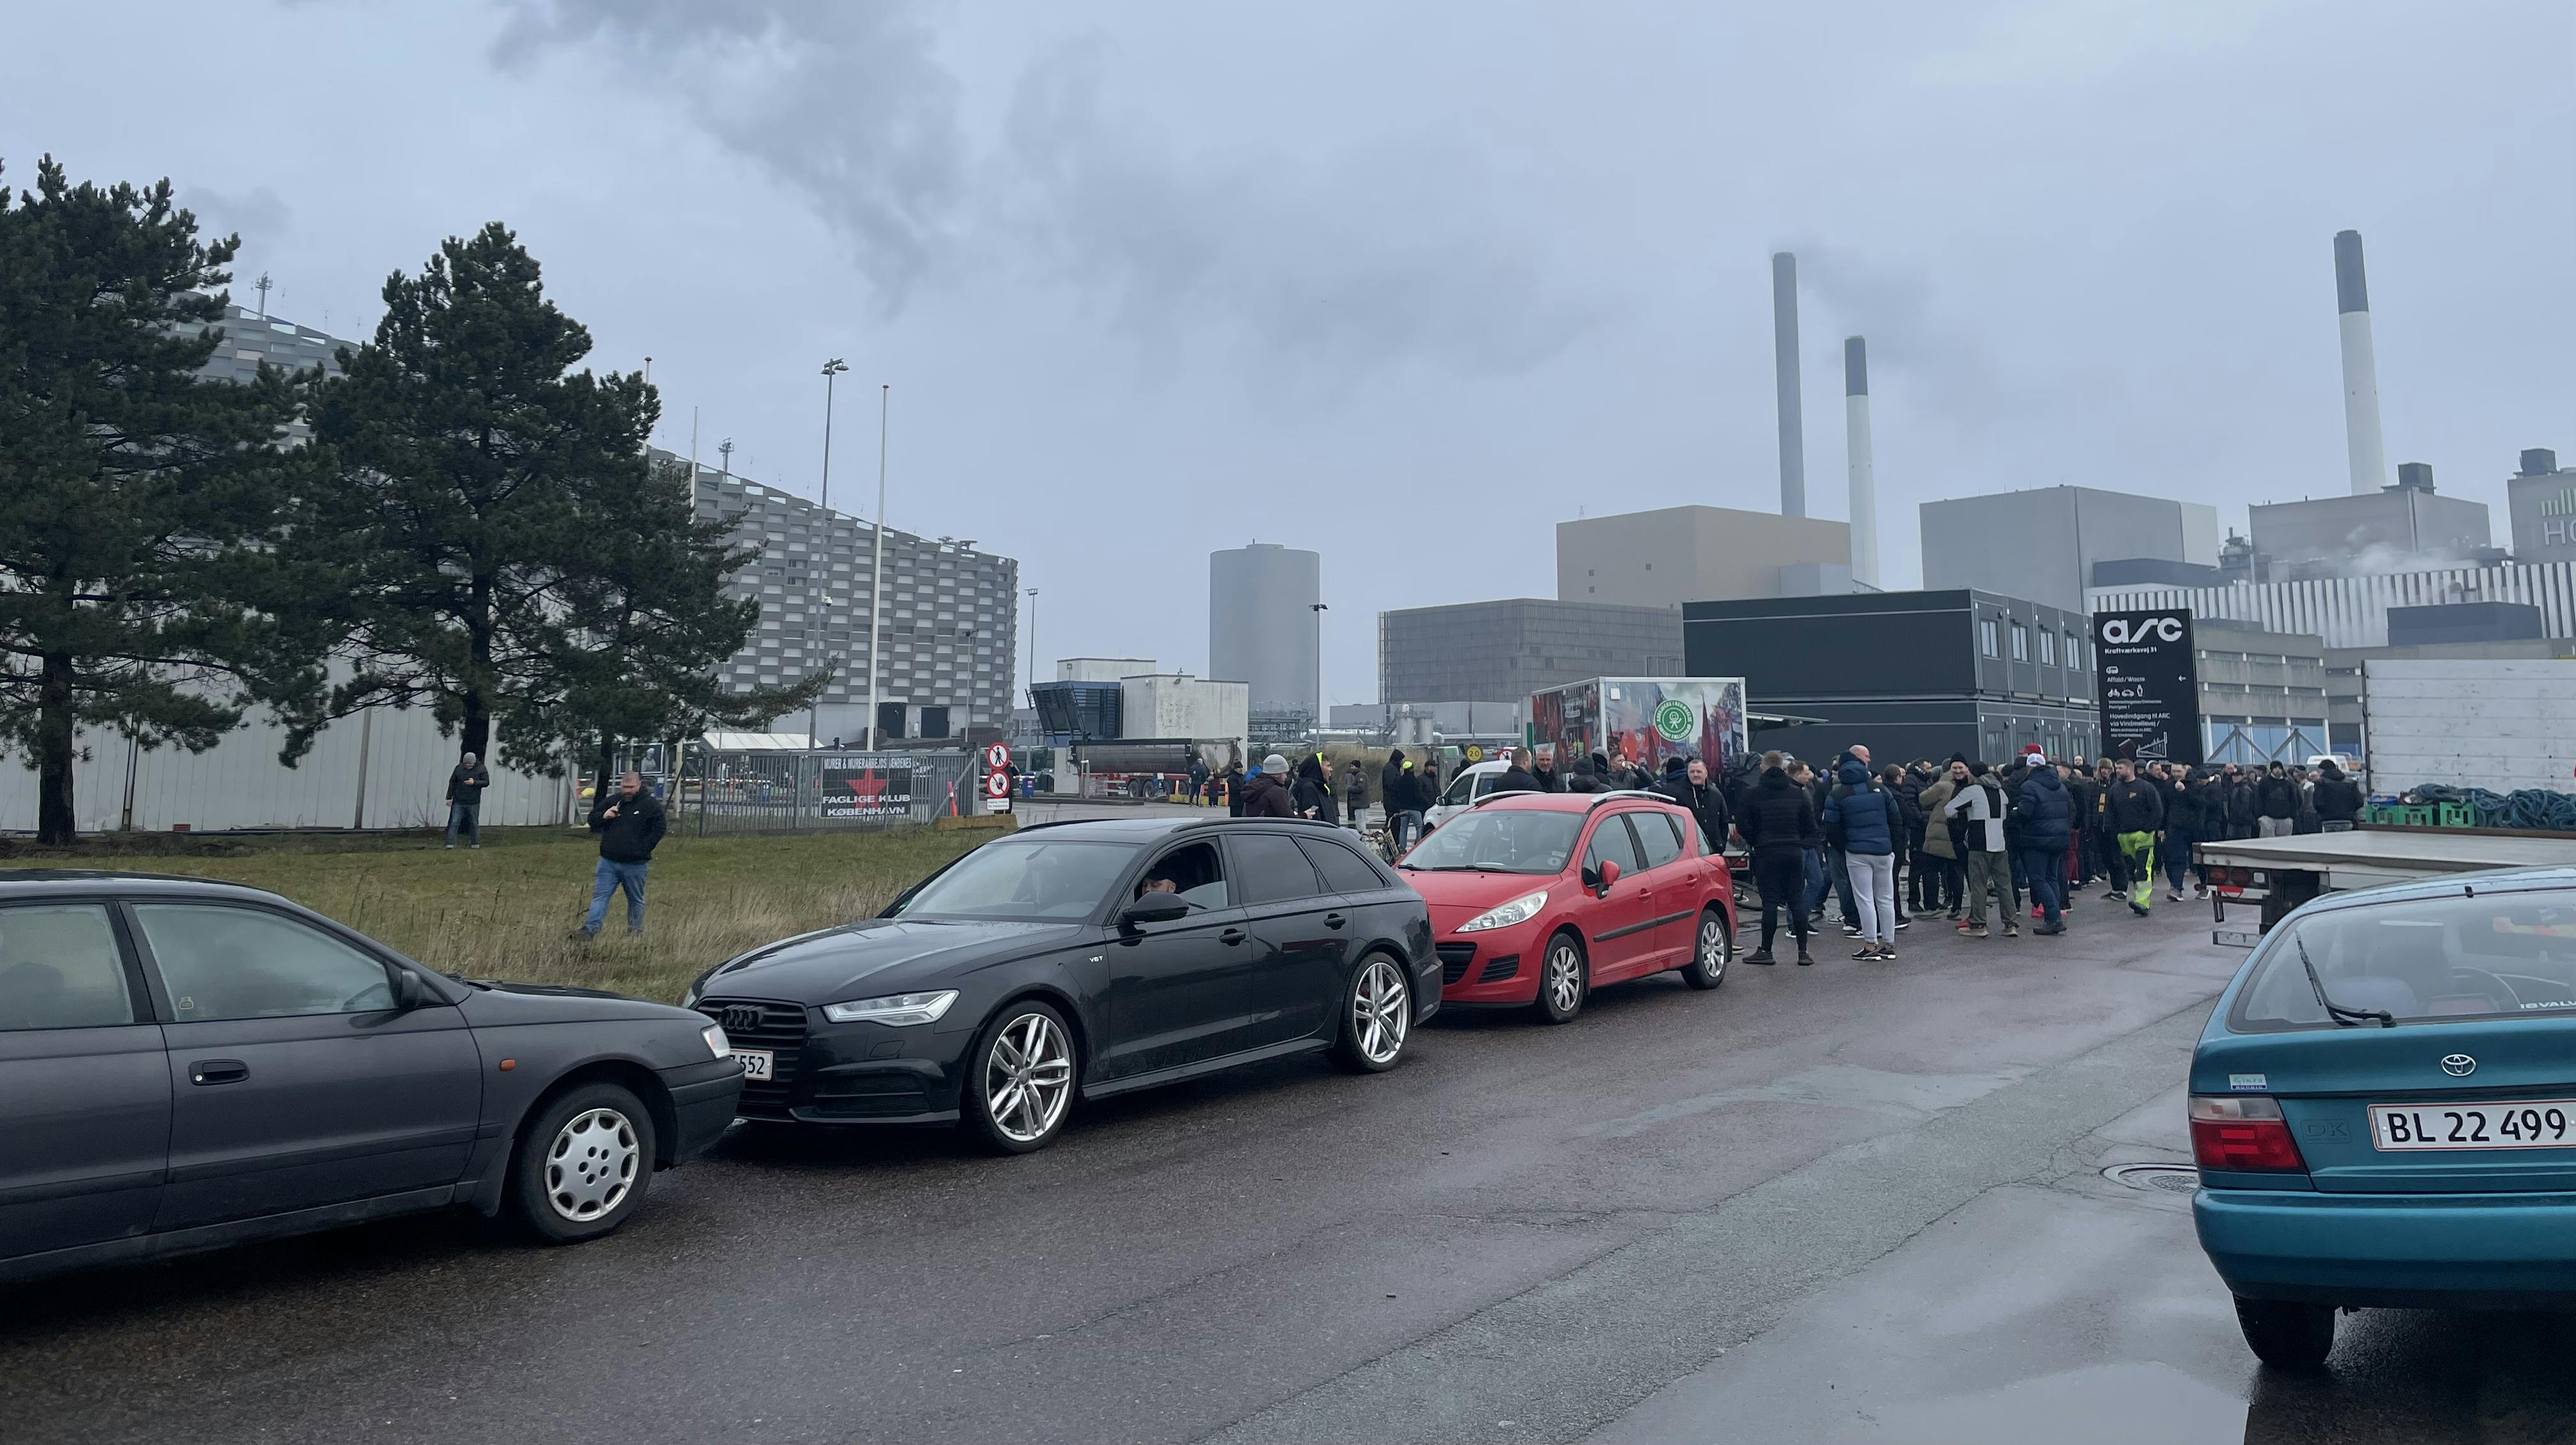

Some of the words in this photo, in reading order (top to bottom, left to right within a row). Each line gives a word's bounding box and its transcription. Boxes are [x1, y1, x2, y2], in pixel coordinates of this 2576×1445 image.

[824, 757, 842, 769] MURER
[822, 795, 875, 804] FAGLIGE
[878, 794, 911, 802] KLUB
[827, 807, 905, 816] KØBENHAVN
[2387, 1113, 2436, 1142] BL
[2444, 1112, 2490, 1142] 22
[2500, 1108, 2566, 1141] 499
